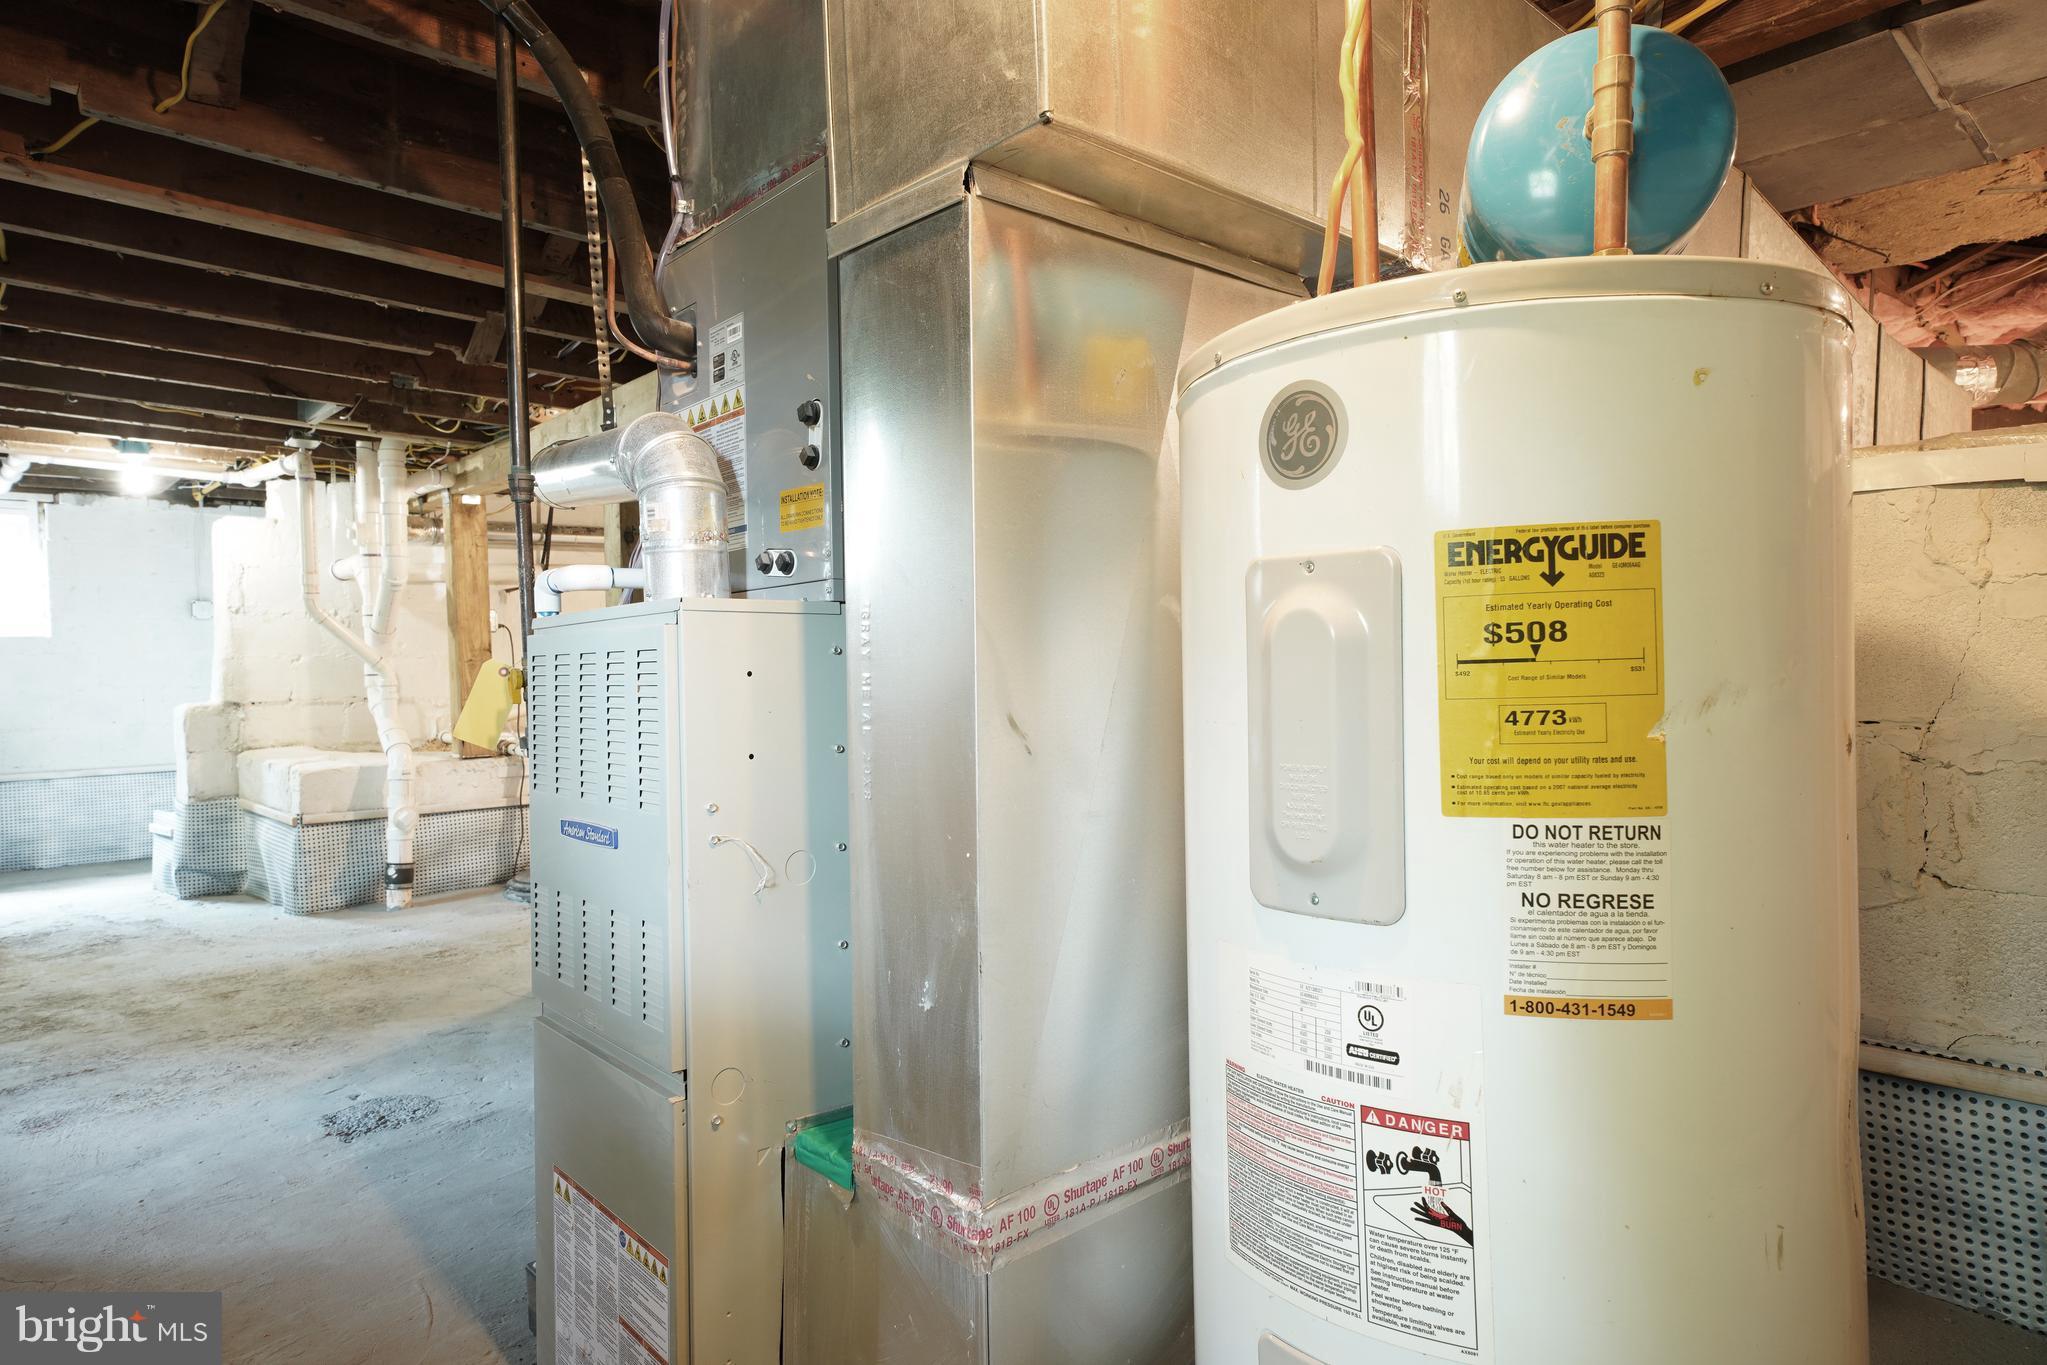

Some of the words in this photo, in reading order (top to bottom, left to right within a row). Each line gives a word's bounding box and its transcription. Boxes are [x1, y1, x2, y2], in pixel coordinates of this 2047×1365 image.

[1439, 187, 1450, 215] 26
[1440, 236, 1451, 261] GA
[1447, 532, 1647, 568] ENERGYGUIDE
[1485, 602, 1524, 612] Estimated
[1526, 602, 1552, 611] Yearly
[1554, 600, 1593, 610] Operating
[1595, 599, 1613, 608] Cost
[1483, 620, 1568, 647] $508
[1504, 709, 1567, 726] 4773
[1569, 716, 1582, 724] kWh
[1538, 729, 1551, 737] Yearly
[1553, 729, 1576, 737] Electricity
[1469, 757, 1485, 765] Your
[1486, 757, 1500, 765] cost
[1502, 756, 1515, 764] will
[1516, 756, 1542, 766] depend
[1554, 758, 1568, 766] your
[1571, 756, 1590, 765] utility
[1592, 756, 1608, 764] rates
[1610, 756, 1623, 764] and
[586, 827, 611, 844] Standard
[1512, 824, 1539, 840] DO
[1545, 825, 1583, 840] NOT
[1589, 825, 1661, 841] RETURN
[1514, 857, 1544, 865] operation
[1537, 850, 1578, 858] experiencing
[1579, 850, 1608, 858] problems
[1521, 892, 1551, 908] NO
[1558, 893, 1655, 910] REGRESE
[1537, 909, 1577, 917] calentador
[1590, 911, 1609, 919] agua
[1509, 999, 1636, 1017] 1-800-431-1549
[1321, 1095, 1355, 1109] CAUTION
[1385, 1114, 1463, 1138] DANGER
[1167, 1136, 1191, 1157] Shurt
[947, 1215, 993, 1244] Shurtape
[999, 1214, 1014, 1233] AF
[1018, 1205, 1036, 1224] 100
[1063, 1176, 1108, 1204] Shurtape
[1112, 1165, 1125, 1182] AF
[1128, 1157, 1144, 1175] 100
[1065, 1198, 1095, 1220] 181A-P
[1104, 1178, 1138, 1202] 181B-FX
[1424, 1186, 1447, 1197] HOT
[1440, 1220, 1463, 1231] BURN
[990, 1228, 1029, 1255] 181B-FX
[1369, 1230, 1385, 1238] Water
[1387, 1234, 1423, 1248] temperature
[1376, 1246, 1394, 1255] death
[1394, 1251, 1408, 1259] from
[1410, 1255, 1431, 1264] scalds.
[1381, 1241, 1398, 1249] cause
[1400, 1245, 1420, 1254] severe
[1421, 1249, 1439, 1259] burns
[1440, 1254, 1468, 1264] instantly
[1370, 1253, 1396, 1265] Children,
[1397, 1260, 1422, 1271] disabled
[1437, 1270, 1458, 1280] elderly
[1376, 1262, 1398, 1273] highest
[1400, 1268, 1411, 1276] risk
[1420, 1273, 1437, 1283] being
[1439, 1276, 1466, 1287] scalded.
[1370, 1268, 1381, 1276] See
[1382, 1272, 1414, 1285] instruction
[1415, 1281, 1438, 1290] manual
[1439, 1285, 1460, 1295] before
[1370, 1276, 1390, 1286] setting
[1391, 1282, 1428, 1296] temperature
[1437, 1293, 1454, 1301] water
[1371, 1282, 1390, 1292] heater.
[1371, 1291, 1383, 1299] Feel
[1384, 1296, 1400, 1304] water
[1401, 1299, 1421, 1309] before
[1422, 1304, 1446, 1316] bathing
[1371, 1298, 1403, 1312] showering.
[1371, 1306, 1408, 1321] Temperature
[1409, 1318, 1432, 1329] limiting
[1433, 1323, 1453, 1333] valves
[1371, 1314, 1399, 1327] available,
[1412, 1325, 1437, 1336] manual.
